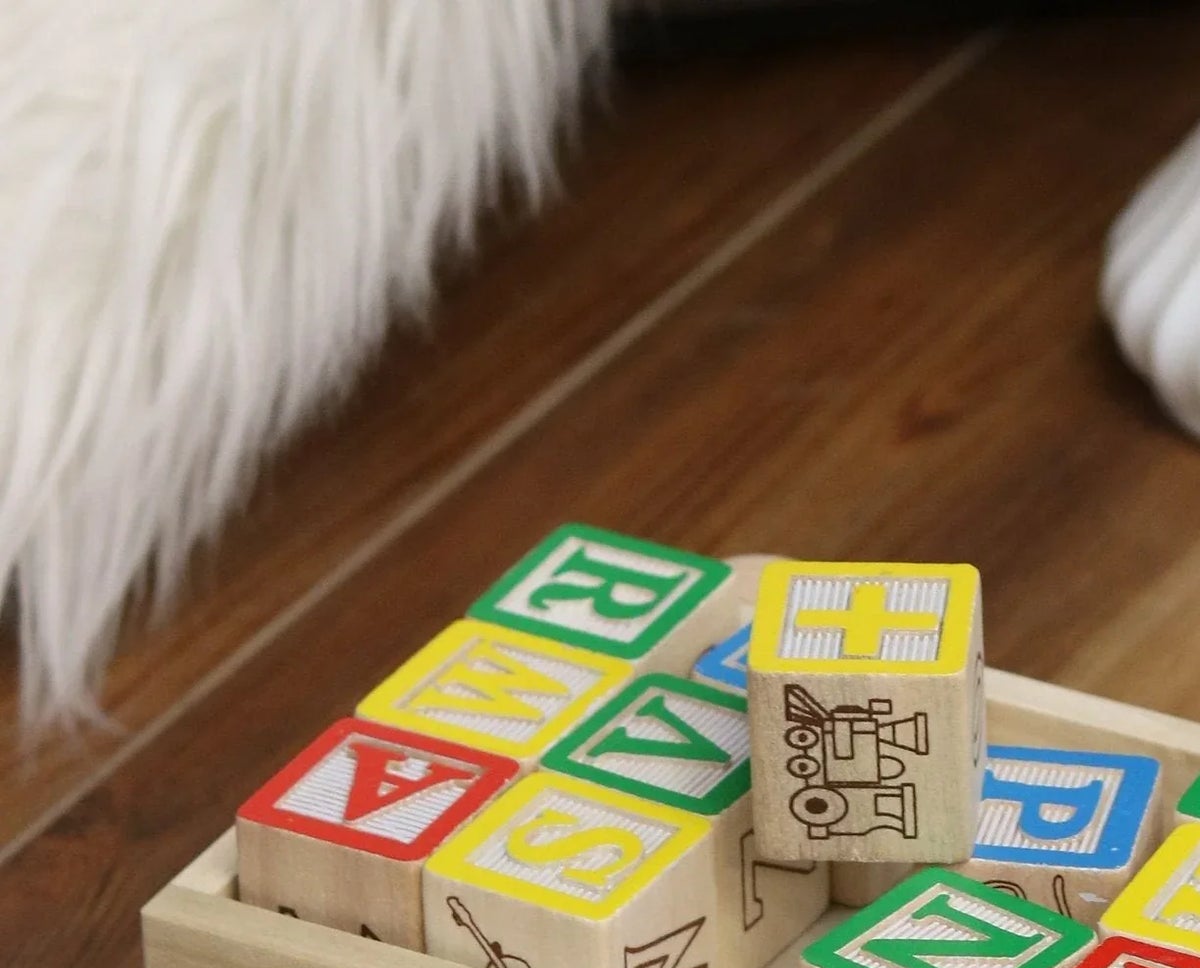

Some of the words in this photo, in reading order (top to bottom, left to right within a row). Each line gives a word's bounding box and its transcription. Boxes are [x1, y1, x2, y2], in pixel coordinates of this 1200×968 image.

[527, 546, 690, 621] R
[588, 694, 732, 768] V
[345, 741, 478, 824] A
[982, 768, 1105, 841] P
[507, 809, 643, 886] S
